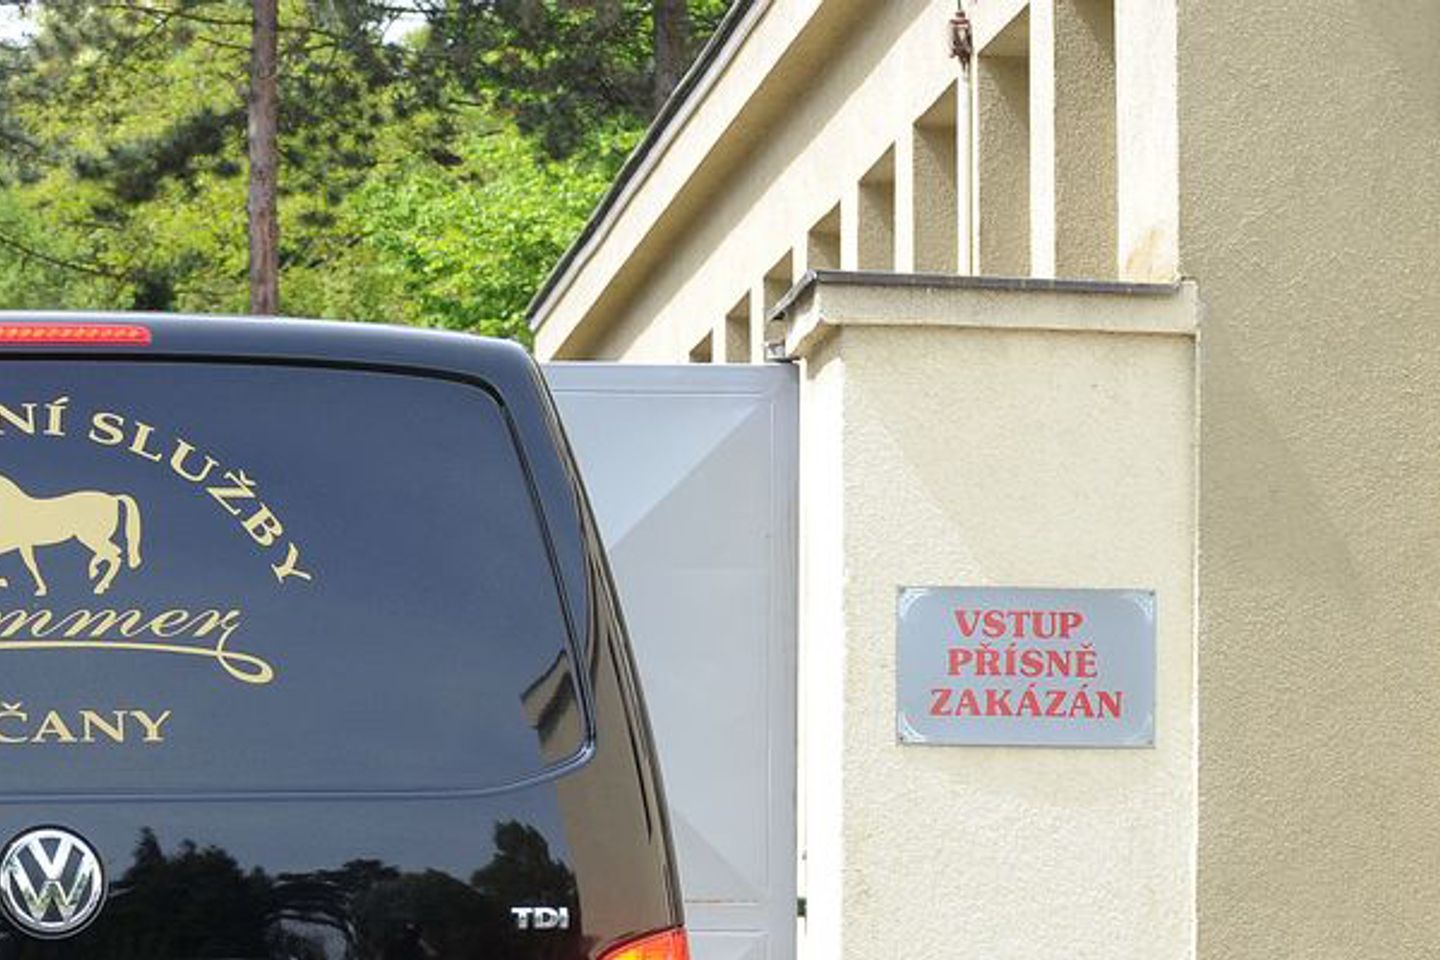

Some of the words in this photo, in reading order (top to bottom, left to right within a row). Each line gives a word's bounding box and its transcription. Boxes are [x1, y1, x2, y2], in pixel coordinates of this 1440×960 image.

[88, 412, 312, 585] SLUŽBY
[954, 610, 1084, 638] VSTUP
[947, 643, 1099, 678] PŘÍSNĚ
[929, 684, 1124, 719] ZAKÁZÁN
[511, 907, 569, 929] TDI
